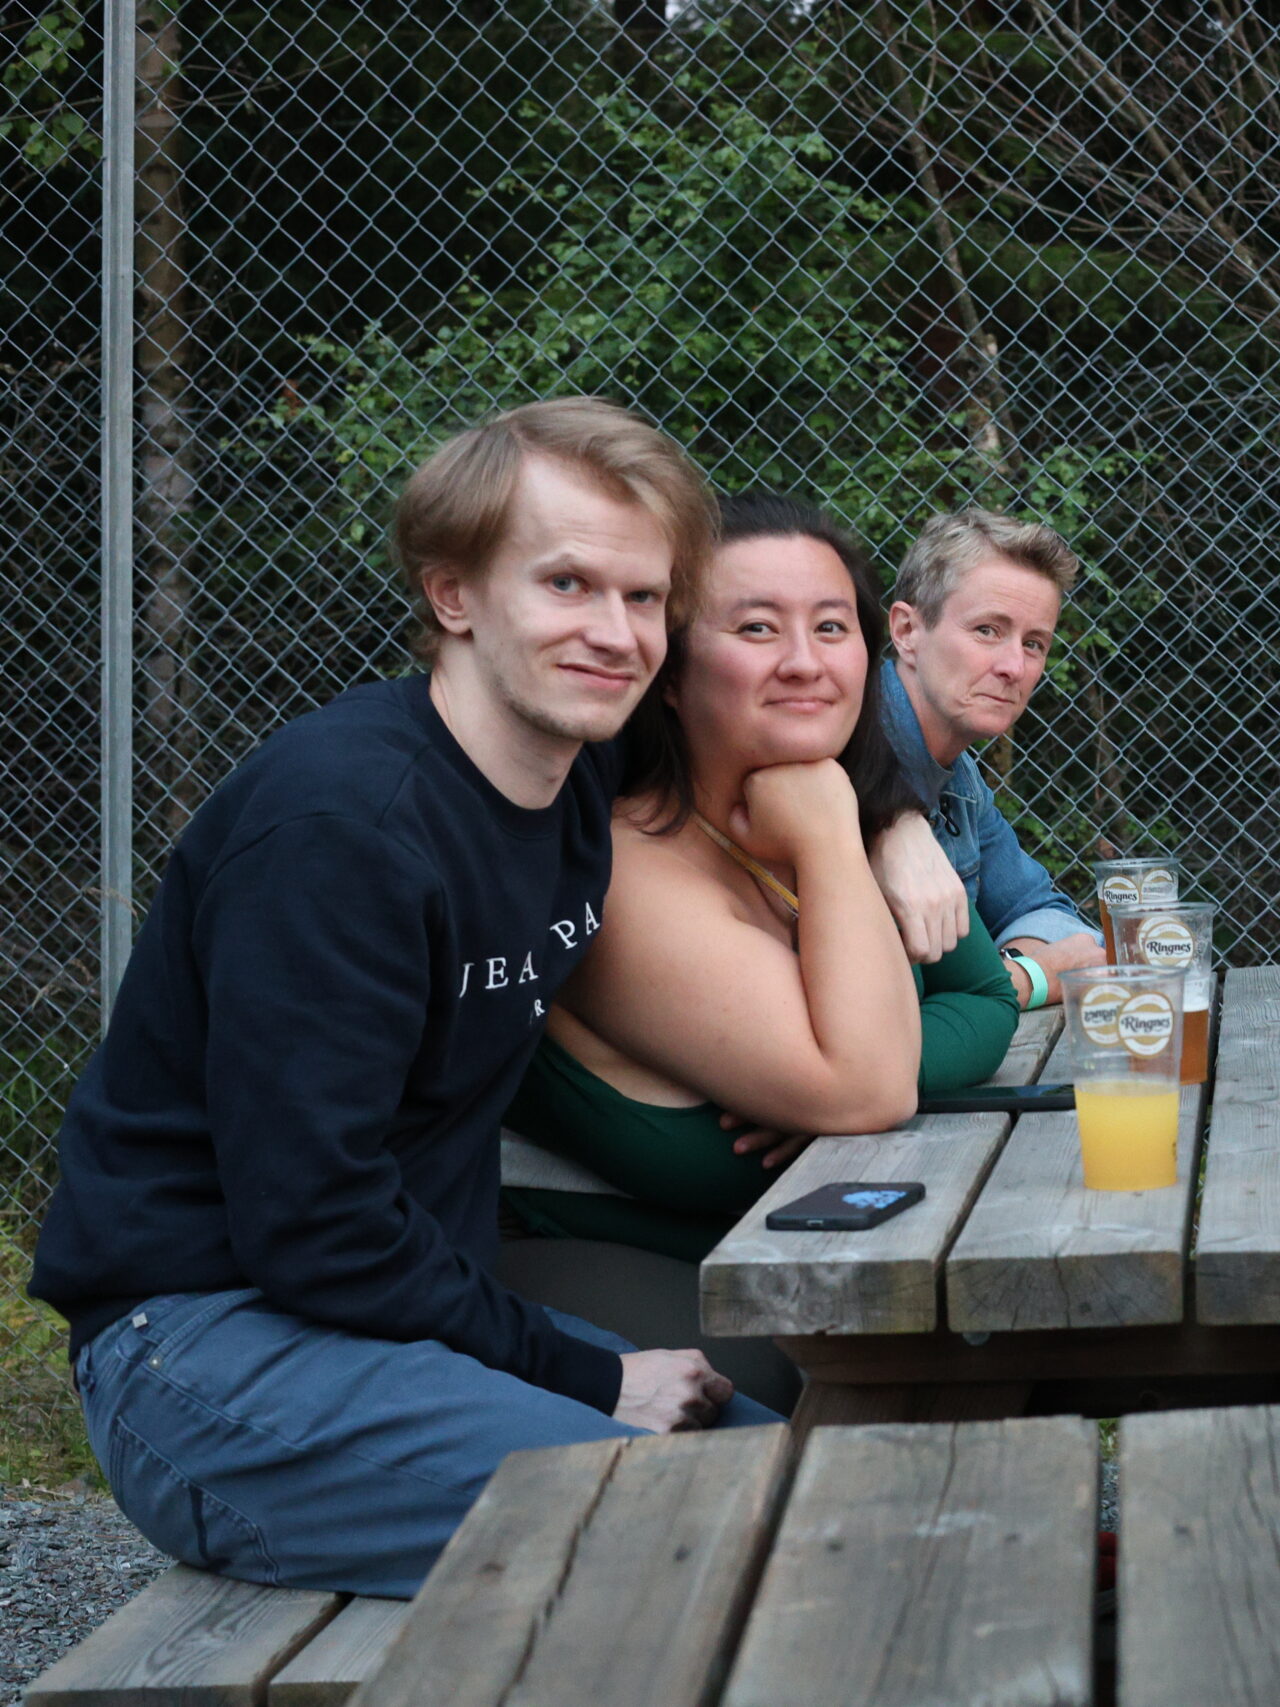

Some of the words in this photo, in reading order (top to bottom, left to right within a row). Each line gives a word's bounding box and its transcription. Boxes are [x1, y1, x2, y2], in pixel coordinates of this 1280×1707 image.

[1105, 891, 1137, 903] Ringnes
[459, 951, 539, 998] JEA
[550, 901, 600, 949] PA
[1147, 941, 1191, 955] Ringnes
[1121, 1016, 1170, 1032] Ringnes
